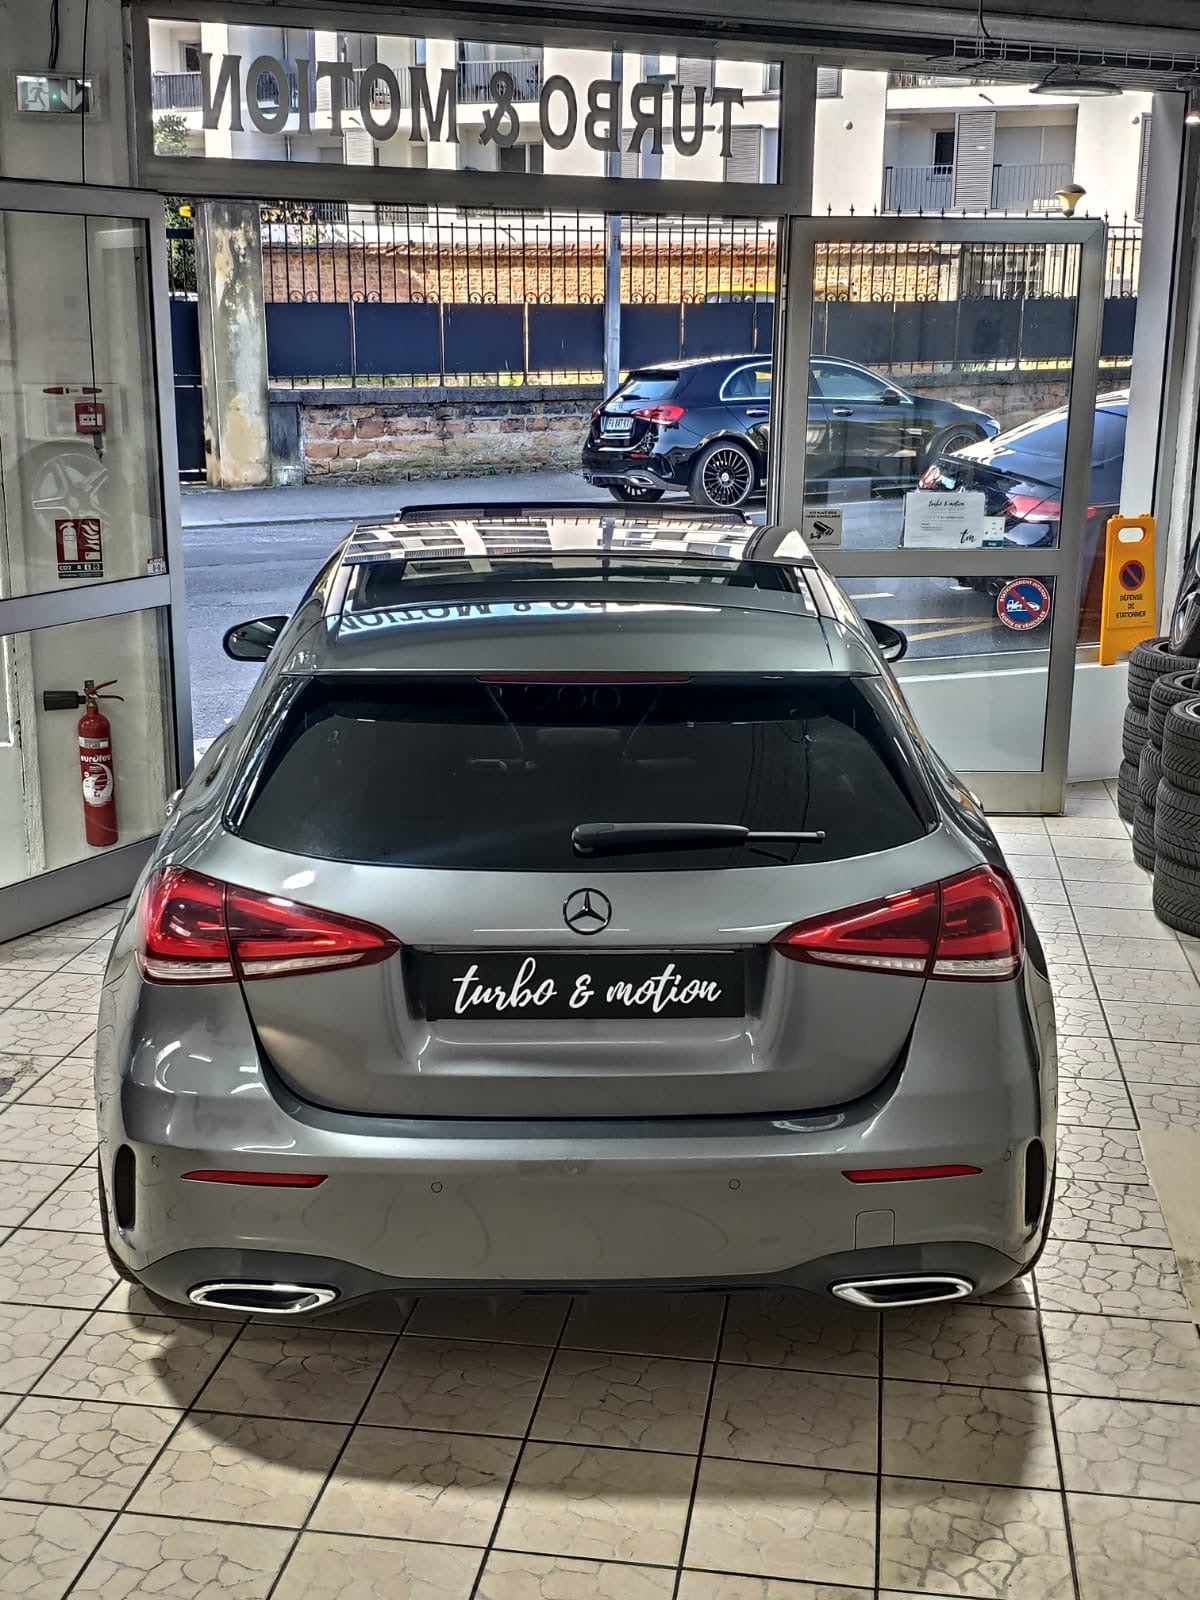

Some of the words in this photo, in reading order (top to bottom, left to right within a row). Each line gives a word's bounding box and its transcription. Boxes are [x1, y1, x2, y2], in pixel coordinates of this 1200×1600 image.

[1000, 579, 1032, 602] STATIONNEMENT
[1119, 593, 1144, 602] DÉFENSE
[1127, 602, 1135, 610] DE
[1115, 611, 1146, 619] STATIONNER
[452, 957, 557, 1014] turbo
[568, 974, 595, 1009] &
[606, 963, 722, 1014] motion
